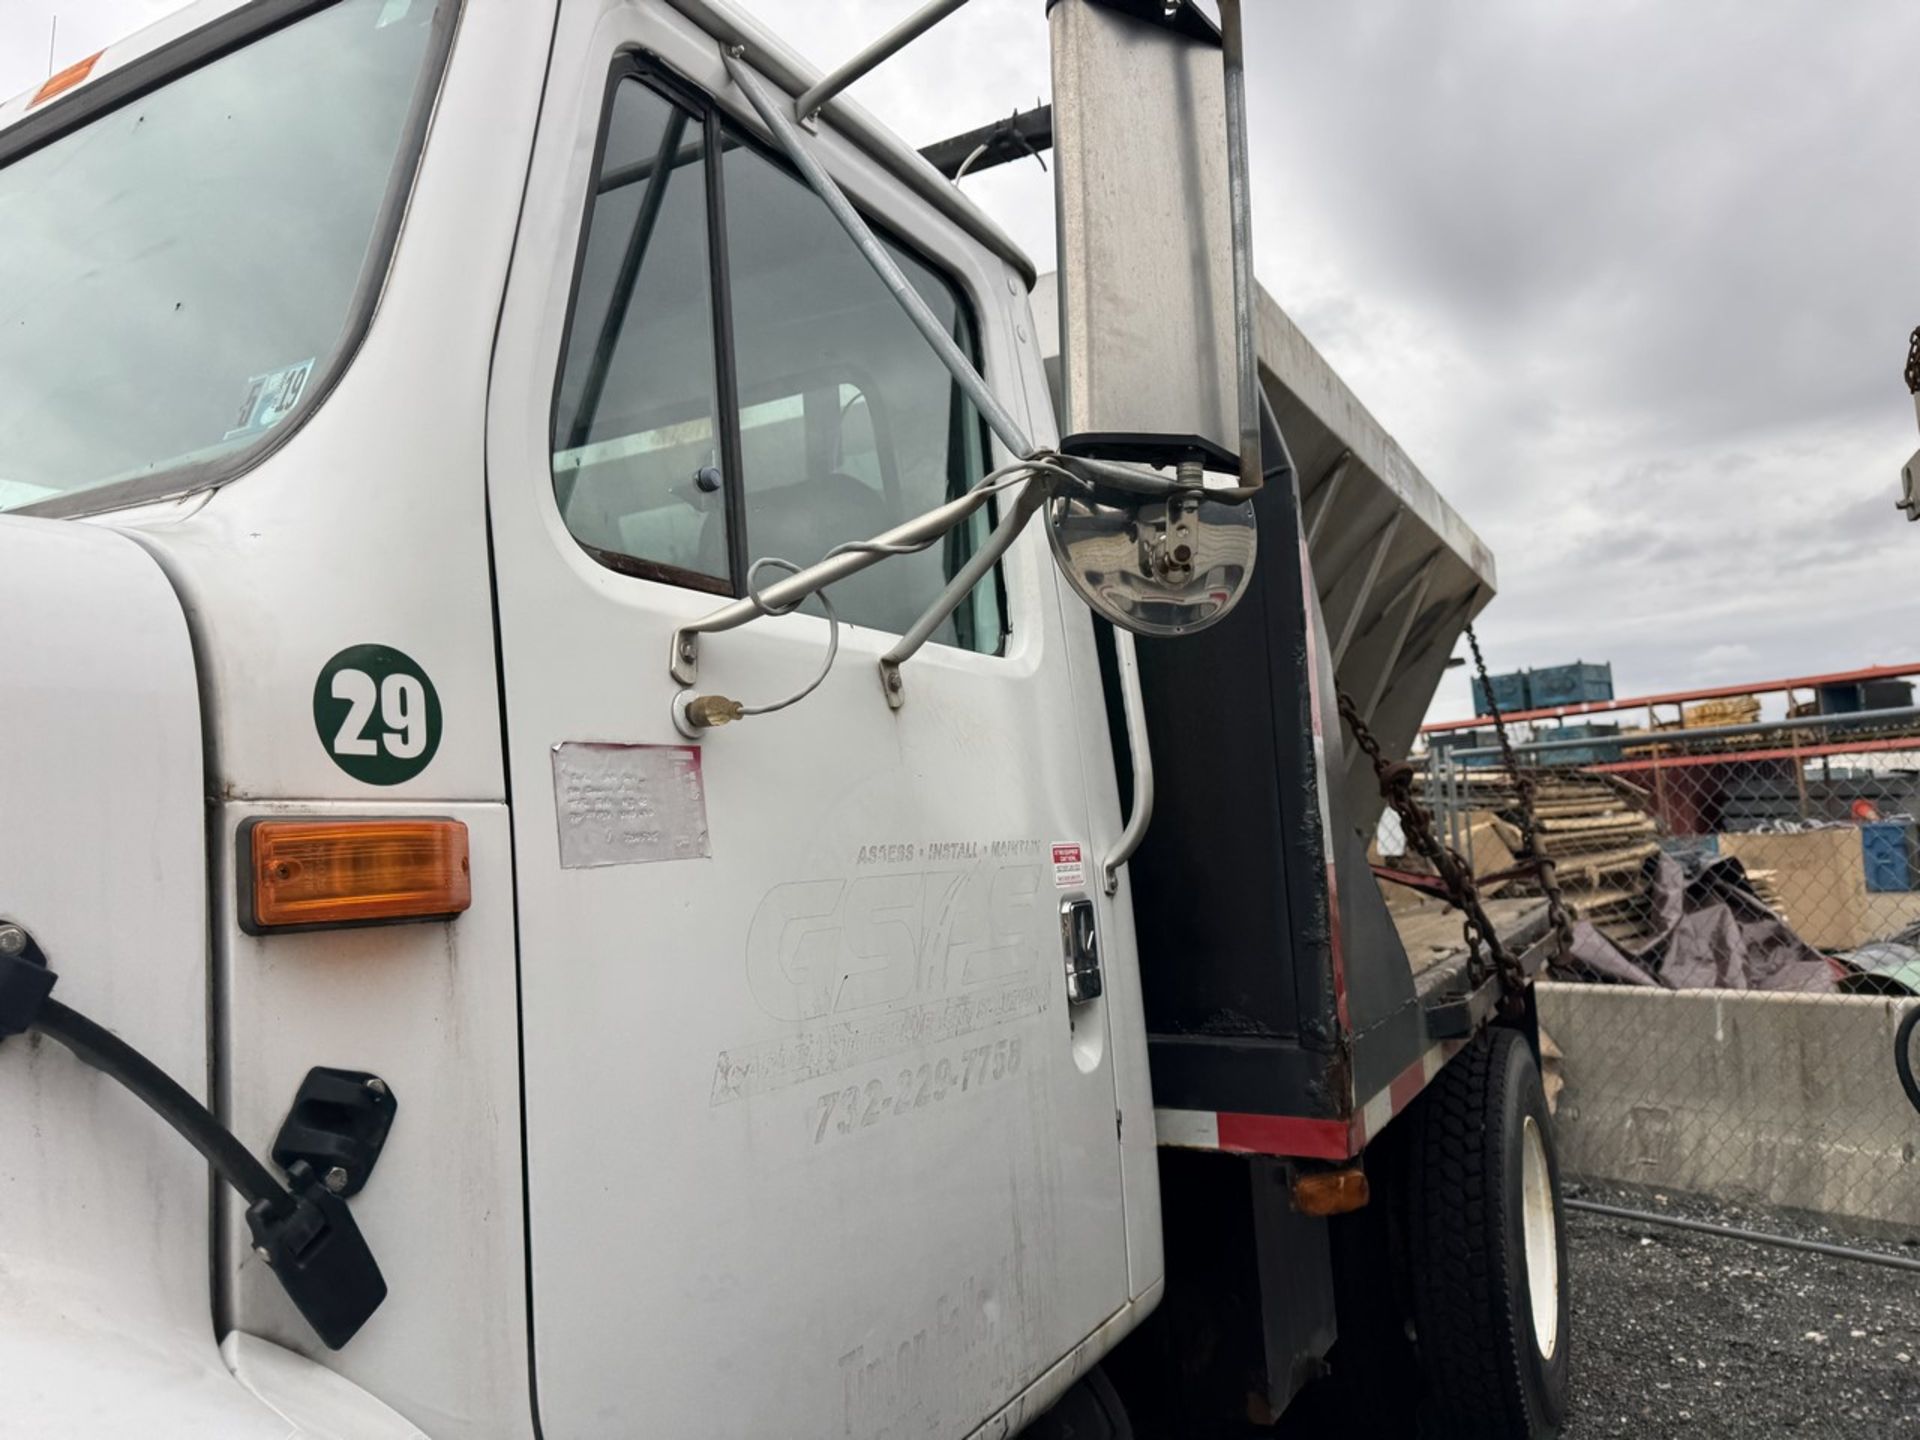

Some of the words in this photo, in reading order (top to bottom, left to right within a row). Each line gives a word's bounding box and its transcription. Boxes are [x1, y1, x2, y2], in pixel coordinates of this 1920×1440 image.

[274, 366, 307, 413] 19
[331, 668, 427, 759] 29
[928, 841, 977, 861] INSTALL
